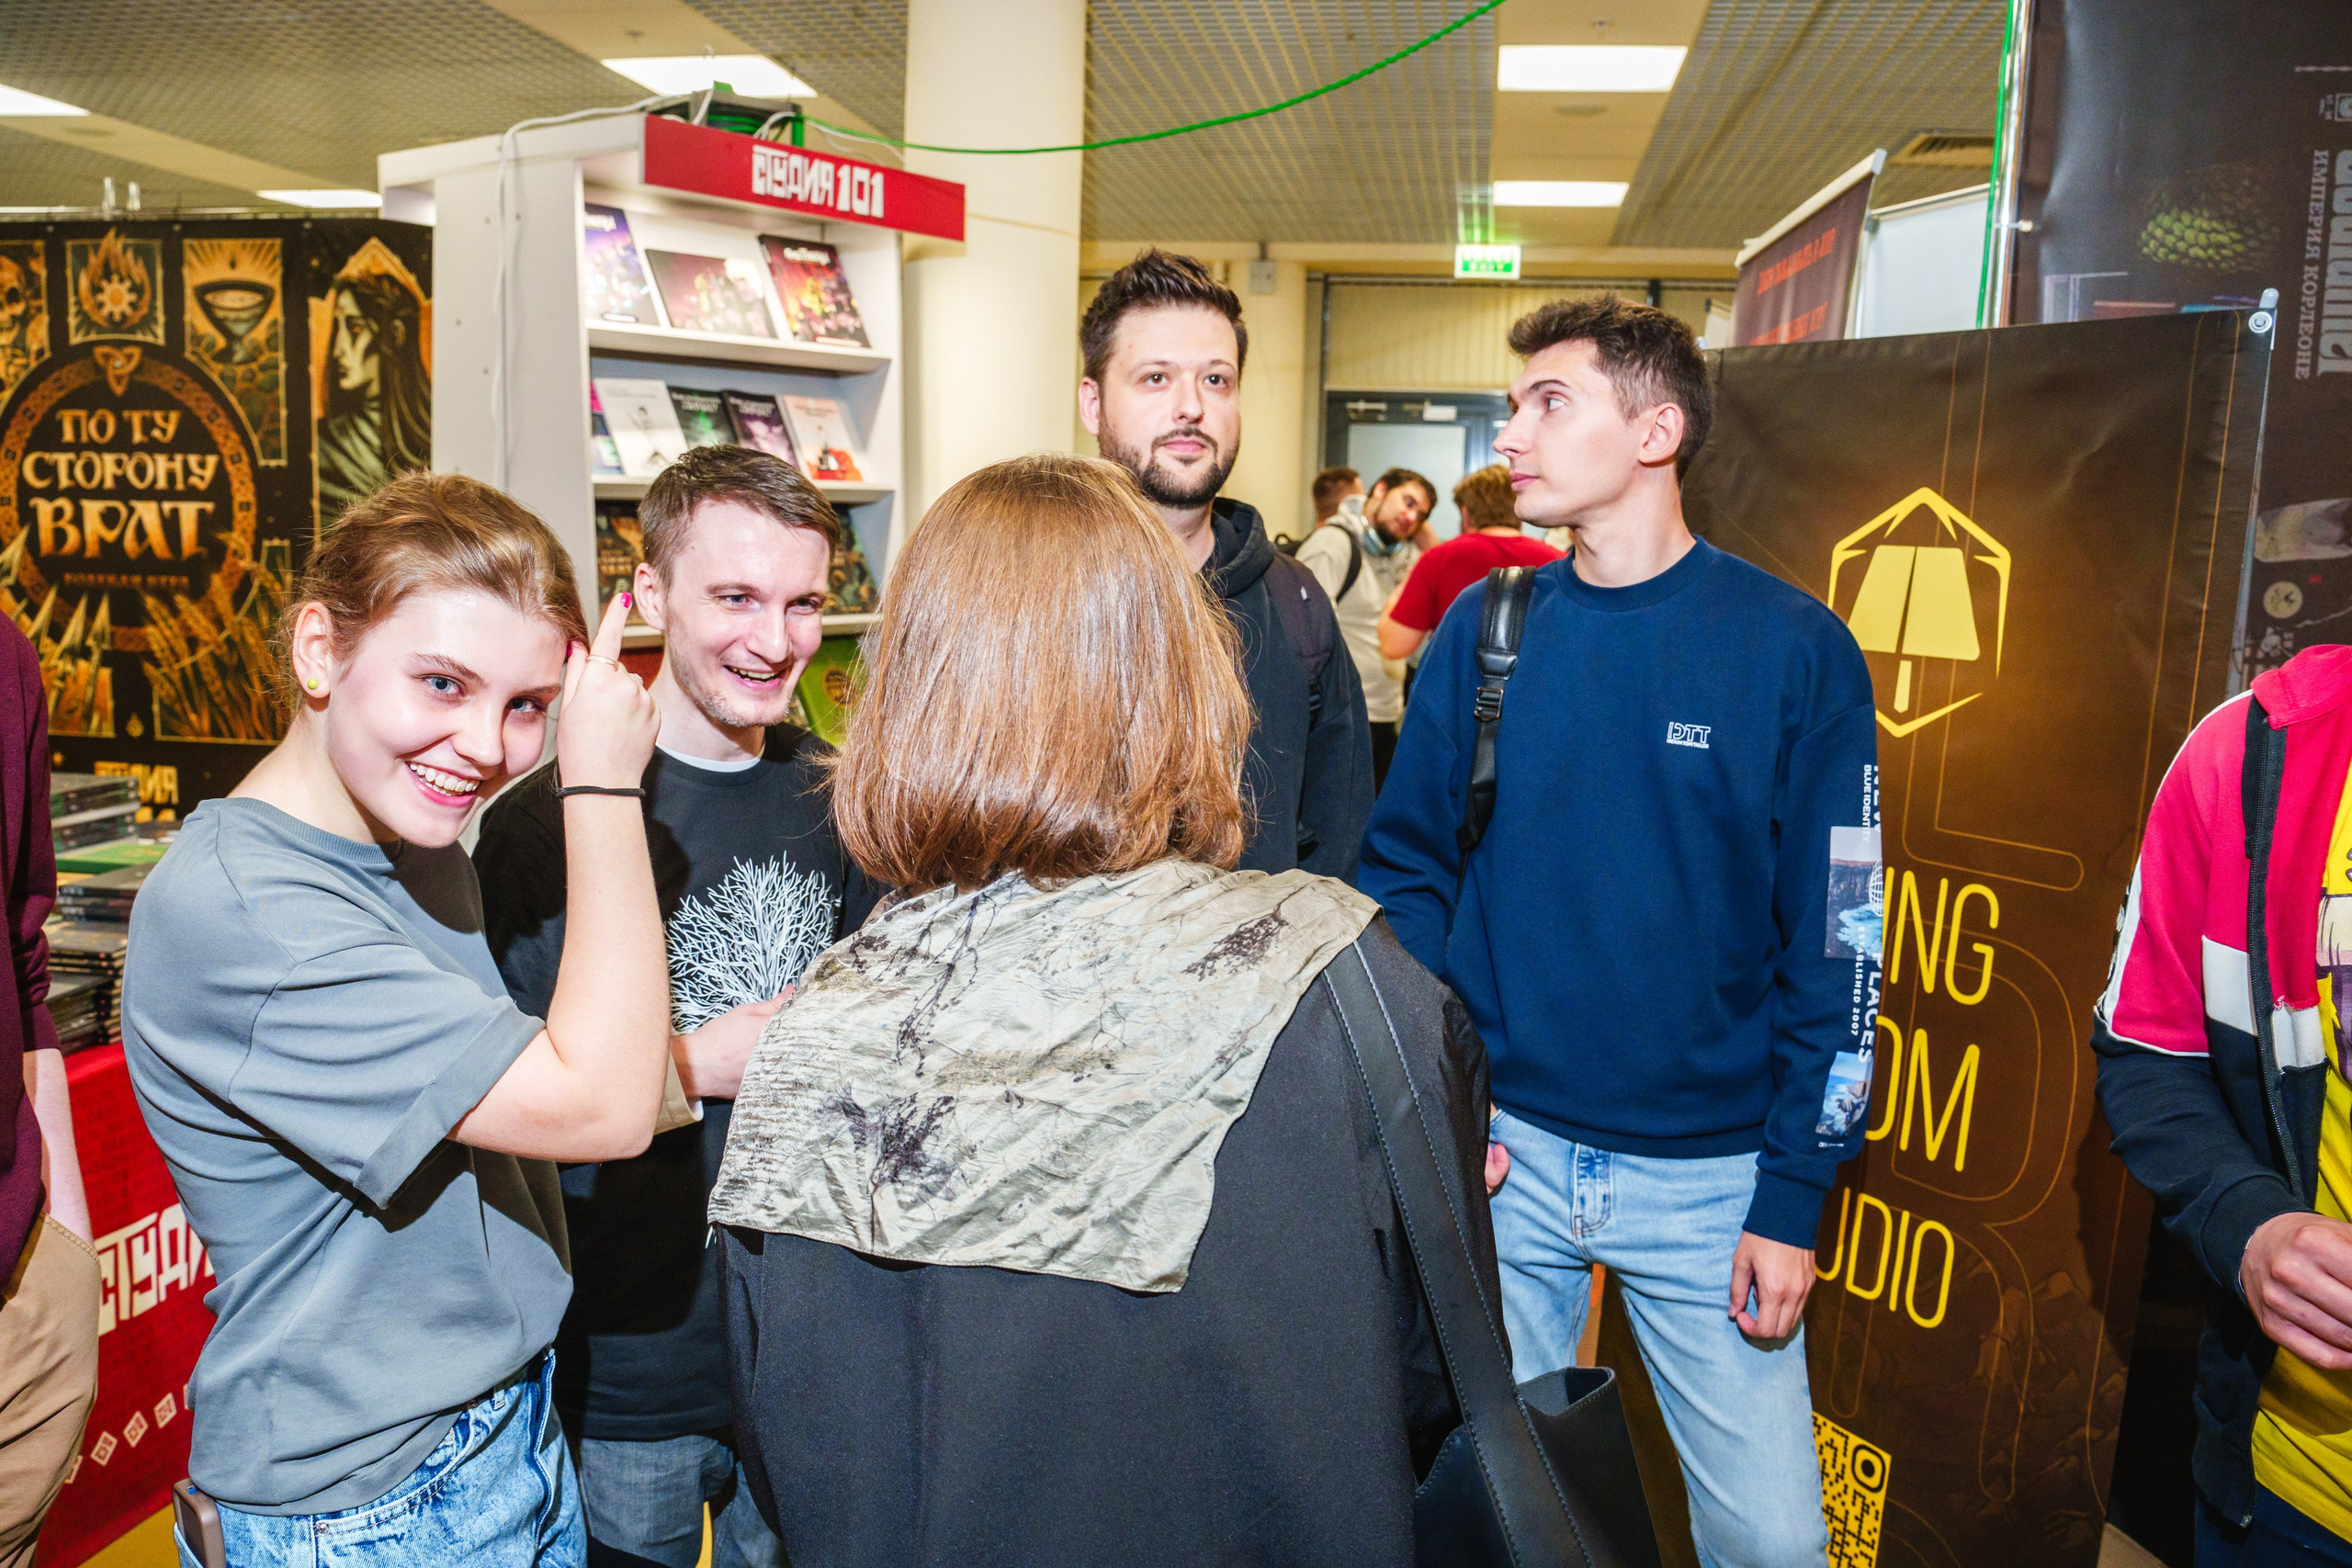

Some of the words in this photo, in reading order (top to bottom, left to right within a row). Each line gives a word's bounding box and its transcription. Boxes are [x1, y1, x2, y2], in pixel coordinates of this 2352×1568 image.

[752, 144, 835, 208] СТУДИЯ
[836, 164, 885, 219] 101
[2305, 149, 2329, 260] ИМПЕРИЯ
[2295, 265, 2320, 380] КОРЛЕОНЕ
[55, 408, 117, 445] ПО
[121, 409, 181, 445] ТУ
[22, 450, 220, 491] СТОРОНУ
[28, 496, 216, 561] ВРАТ
[1862, 764, 1872, 794] BLUE
[1861, 795, 1871, 843] IDENTITY
[1852, 926, 1866, 1004] ESTABLISHED
[1850, 1007, 1860, 1036] 2007
[1858, 952, 1883, 1064] PLACES
